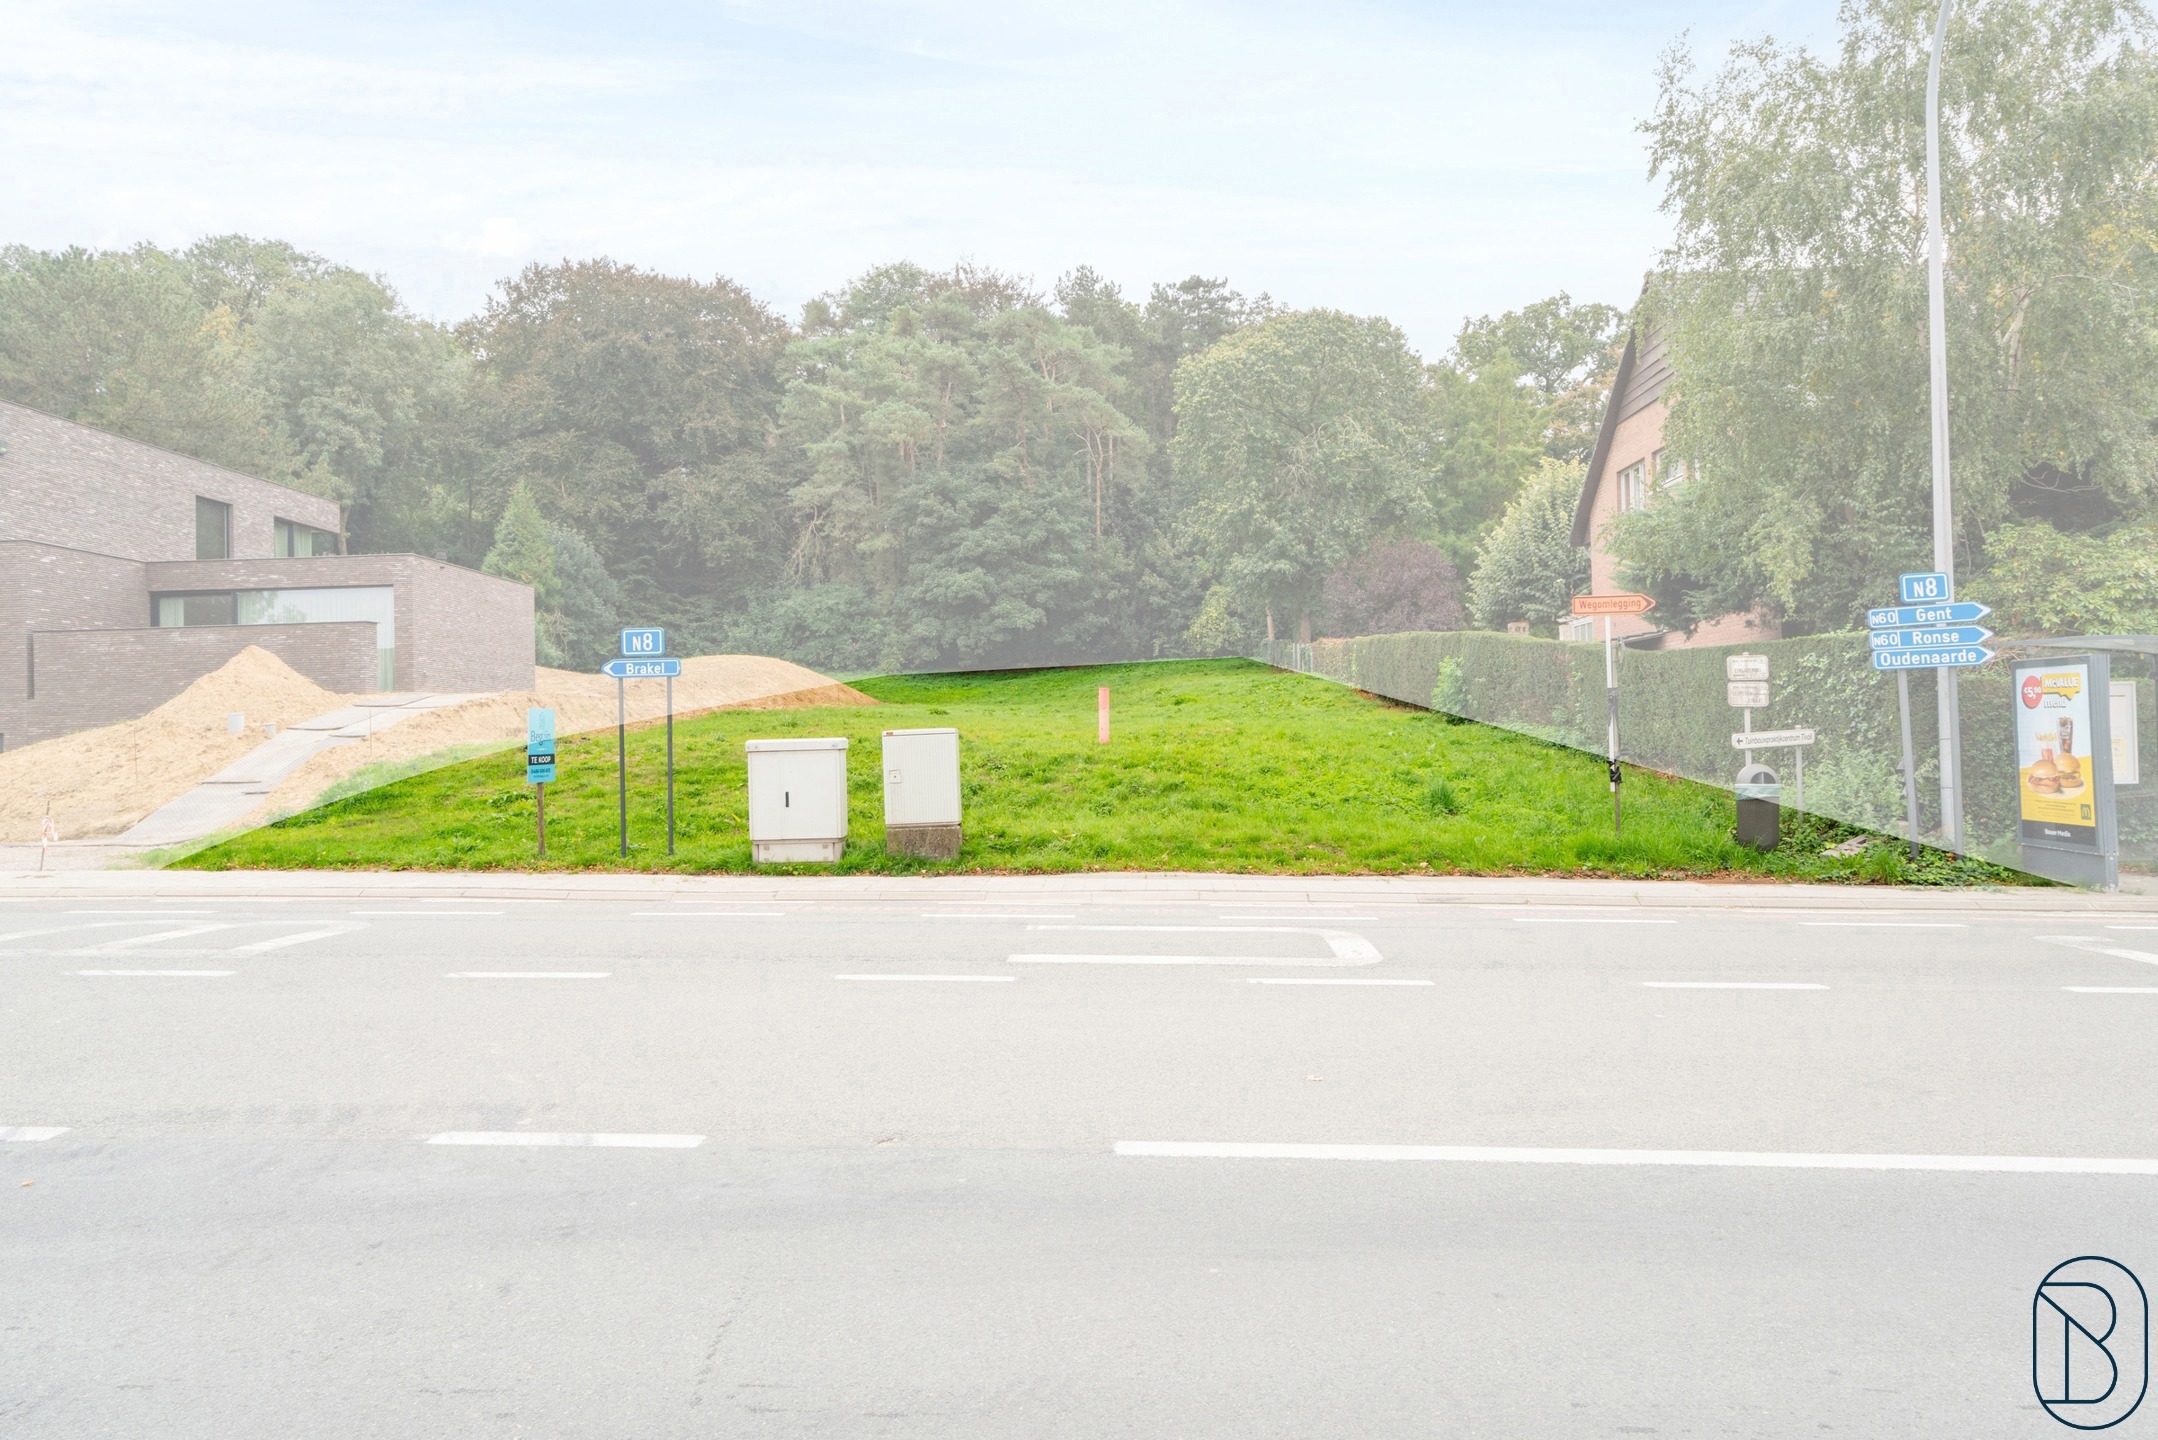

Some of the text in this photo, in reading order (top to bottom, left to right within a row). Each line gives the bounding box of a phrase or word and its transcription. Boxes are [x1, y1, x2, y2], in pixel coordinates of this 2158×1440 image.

[1913, 577, 1938, 597] N8
[1579, 599, 1642, 610] Wegomlegging
[1871, 606, 1953, 625] N60 Gent
[632, 632, 653, 651] N8
[1873, 631, 1960, 646] N60 Ronse
[1880, 649, 1977, 666] Oudenaarde
[625, 662, 665, 674] Brakel
[530, 755, 552, 764] TE KOOP
